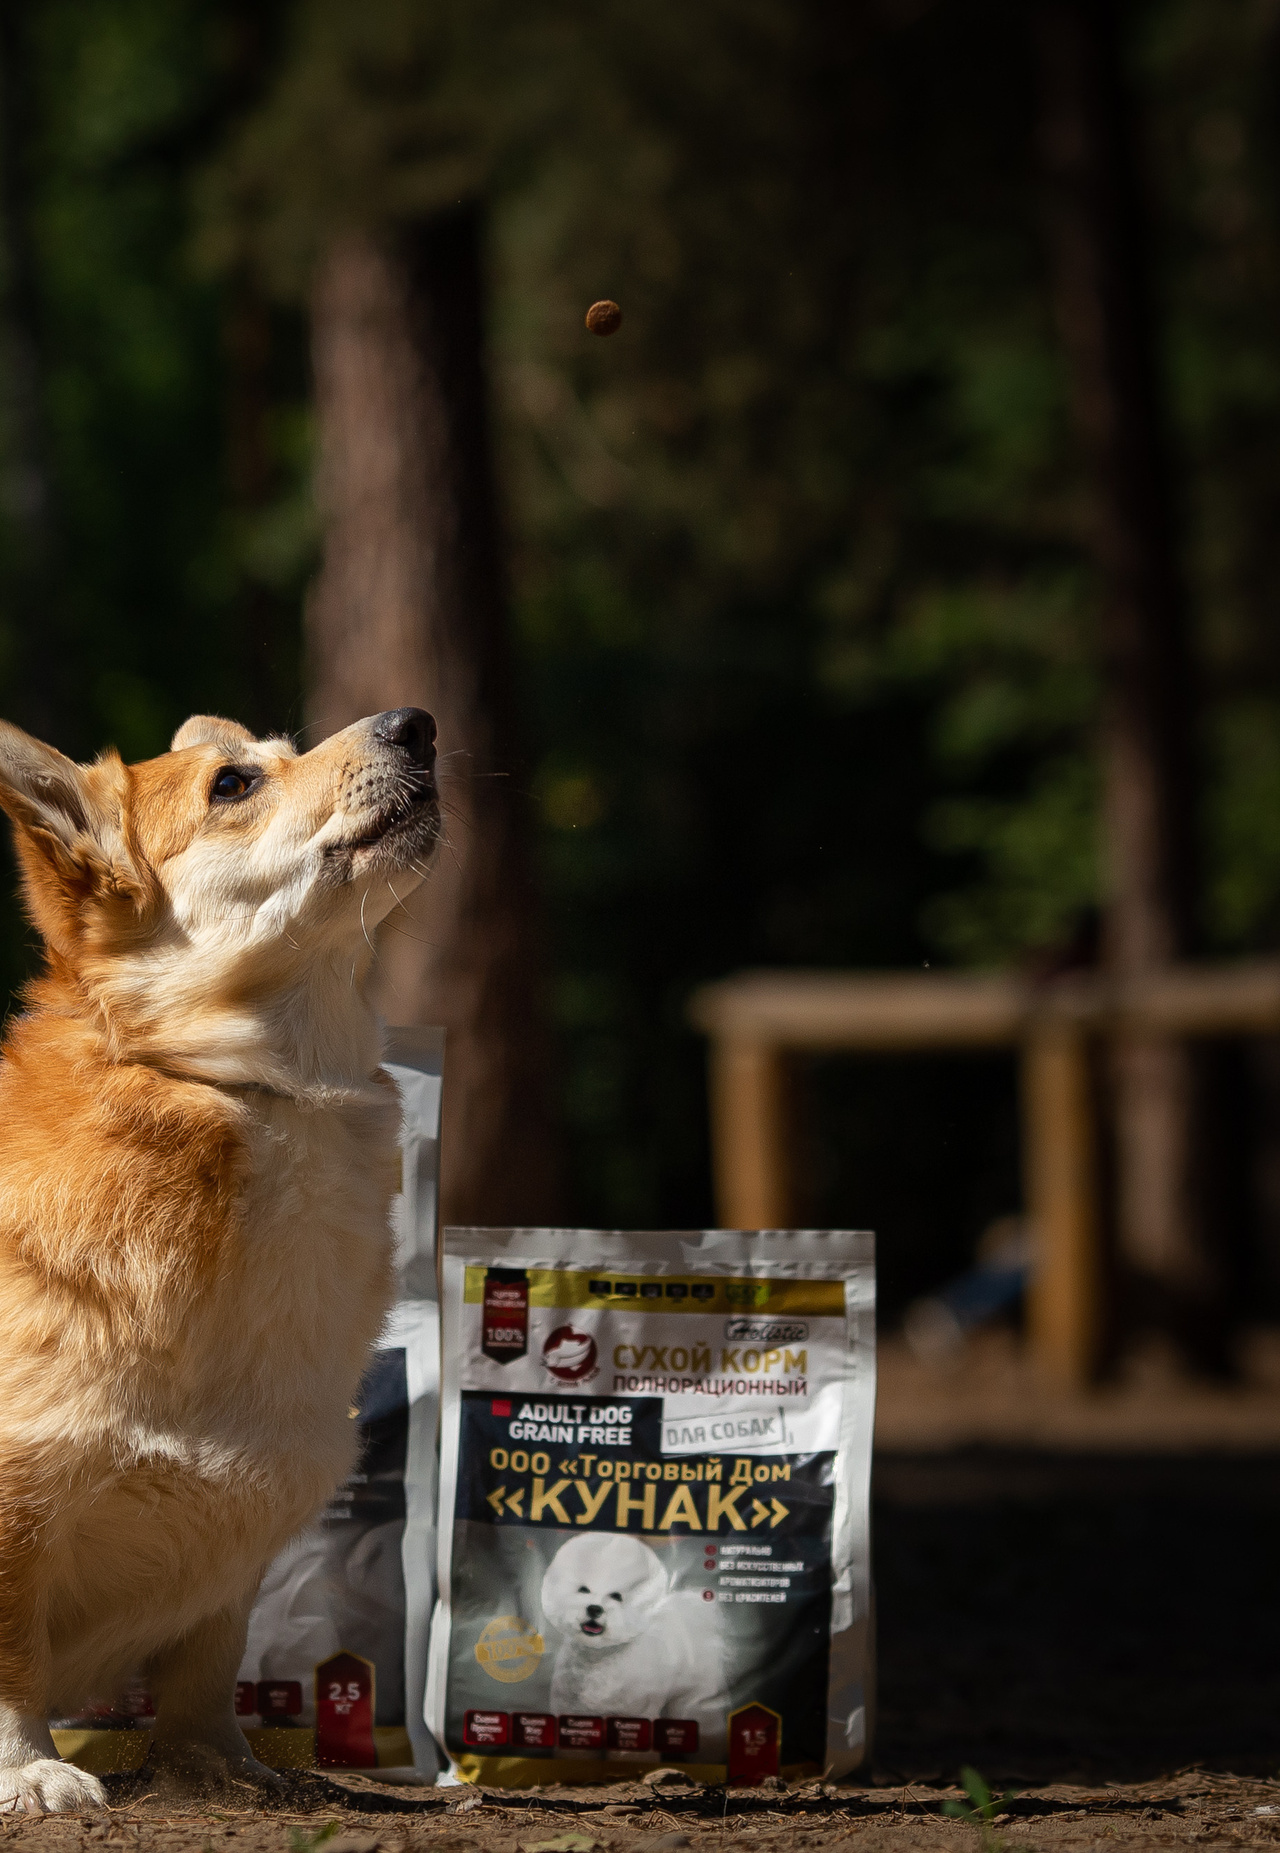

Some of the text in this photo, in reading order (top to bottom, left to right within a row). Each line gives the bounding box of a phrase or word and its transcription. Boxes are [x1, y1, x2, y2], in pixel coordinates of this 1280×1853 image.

[486, 1328, 526, 1342] 100%
[728, 1319, 807, 1342] Holistic
[613, 1343, 808, 1375] СУХОЙ КОРМ
[612, 1375, 808, 1398] ПОЛНОРАЦИОННЫЙ
[518, 1403, 633, 1426] ADULT DOG
[509, 1421, 632, 1446] GRAIN FREE
[710, 1416, 776, 1441] СОБАК
[490, 1449, 791, 1487] ООО «Торговый Дом
[485, 1477, 790, 1531] «КУНАК»
